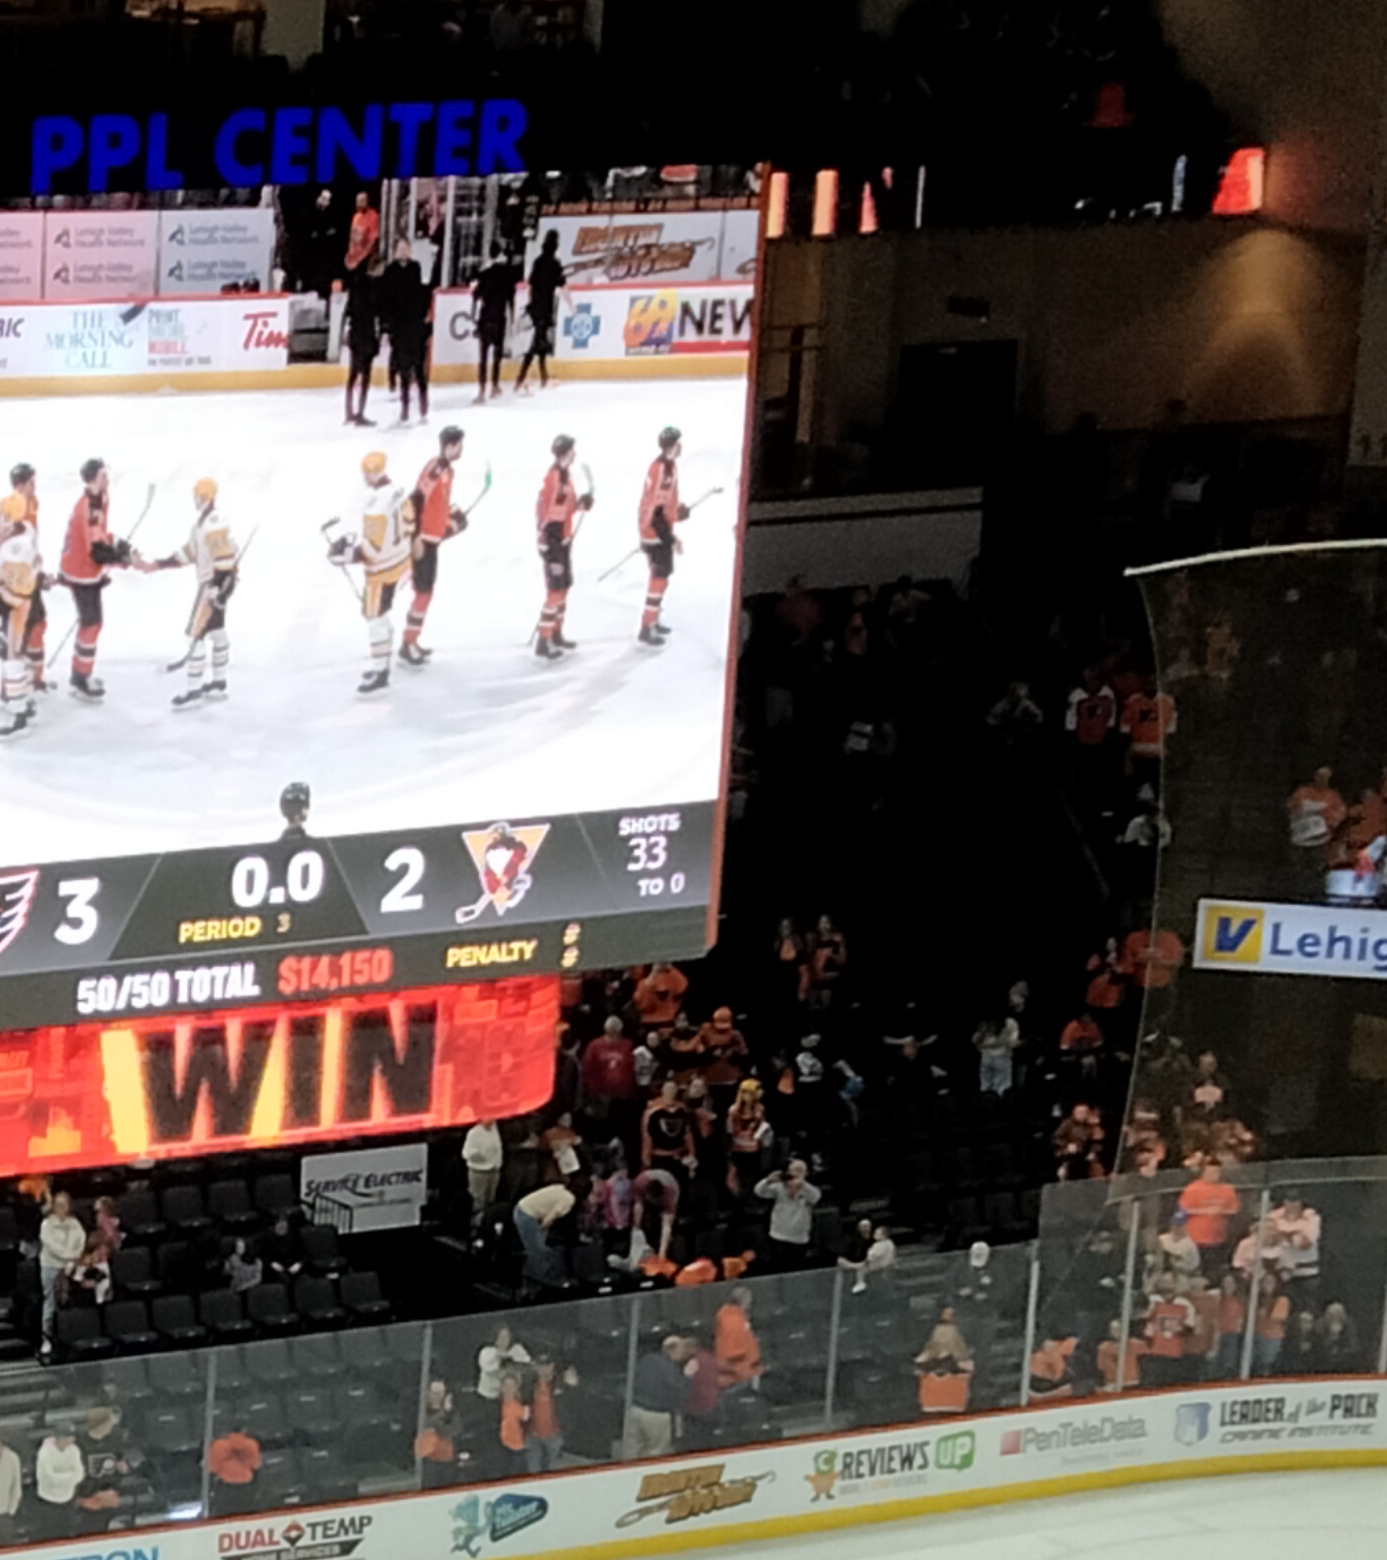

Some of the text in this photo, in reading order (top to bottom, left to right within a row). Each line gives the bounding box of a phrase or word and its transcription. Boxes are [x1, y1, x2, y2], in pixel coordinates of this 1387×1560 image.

[31, 100, 529, 197] PPL CENTER
[617, 813, 681, 837] SHOTS
[627, 836, 667, 871] 33
[230, 850, 325, 908] 0.0
[380, 846, 425, 914] 2
[638, 872, 686, 897] TO 0
[53, 877, 100, 945] 3
[178, 917, 261, 944] PERIOD
[445, 940, 538, 968] PENALTY
[76, 969, 171, 1015] 50/50
[174, 964, 261, 1003] TOTAL
[139, 1005, 437, 1145] WIN
[304, 1169, 424, 1197] SERVICE ELECTRIC
[1219, 1397, 1286, 1427] LEADER
[1328, 1392, 1379, 1419] PACK
[840, 1434, 972, 1481] REVIEWS UP
[218, 1515, 373, 1553] DUAL TEMP
